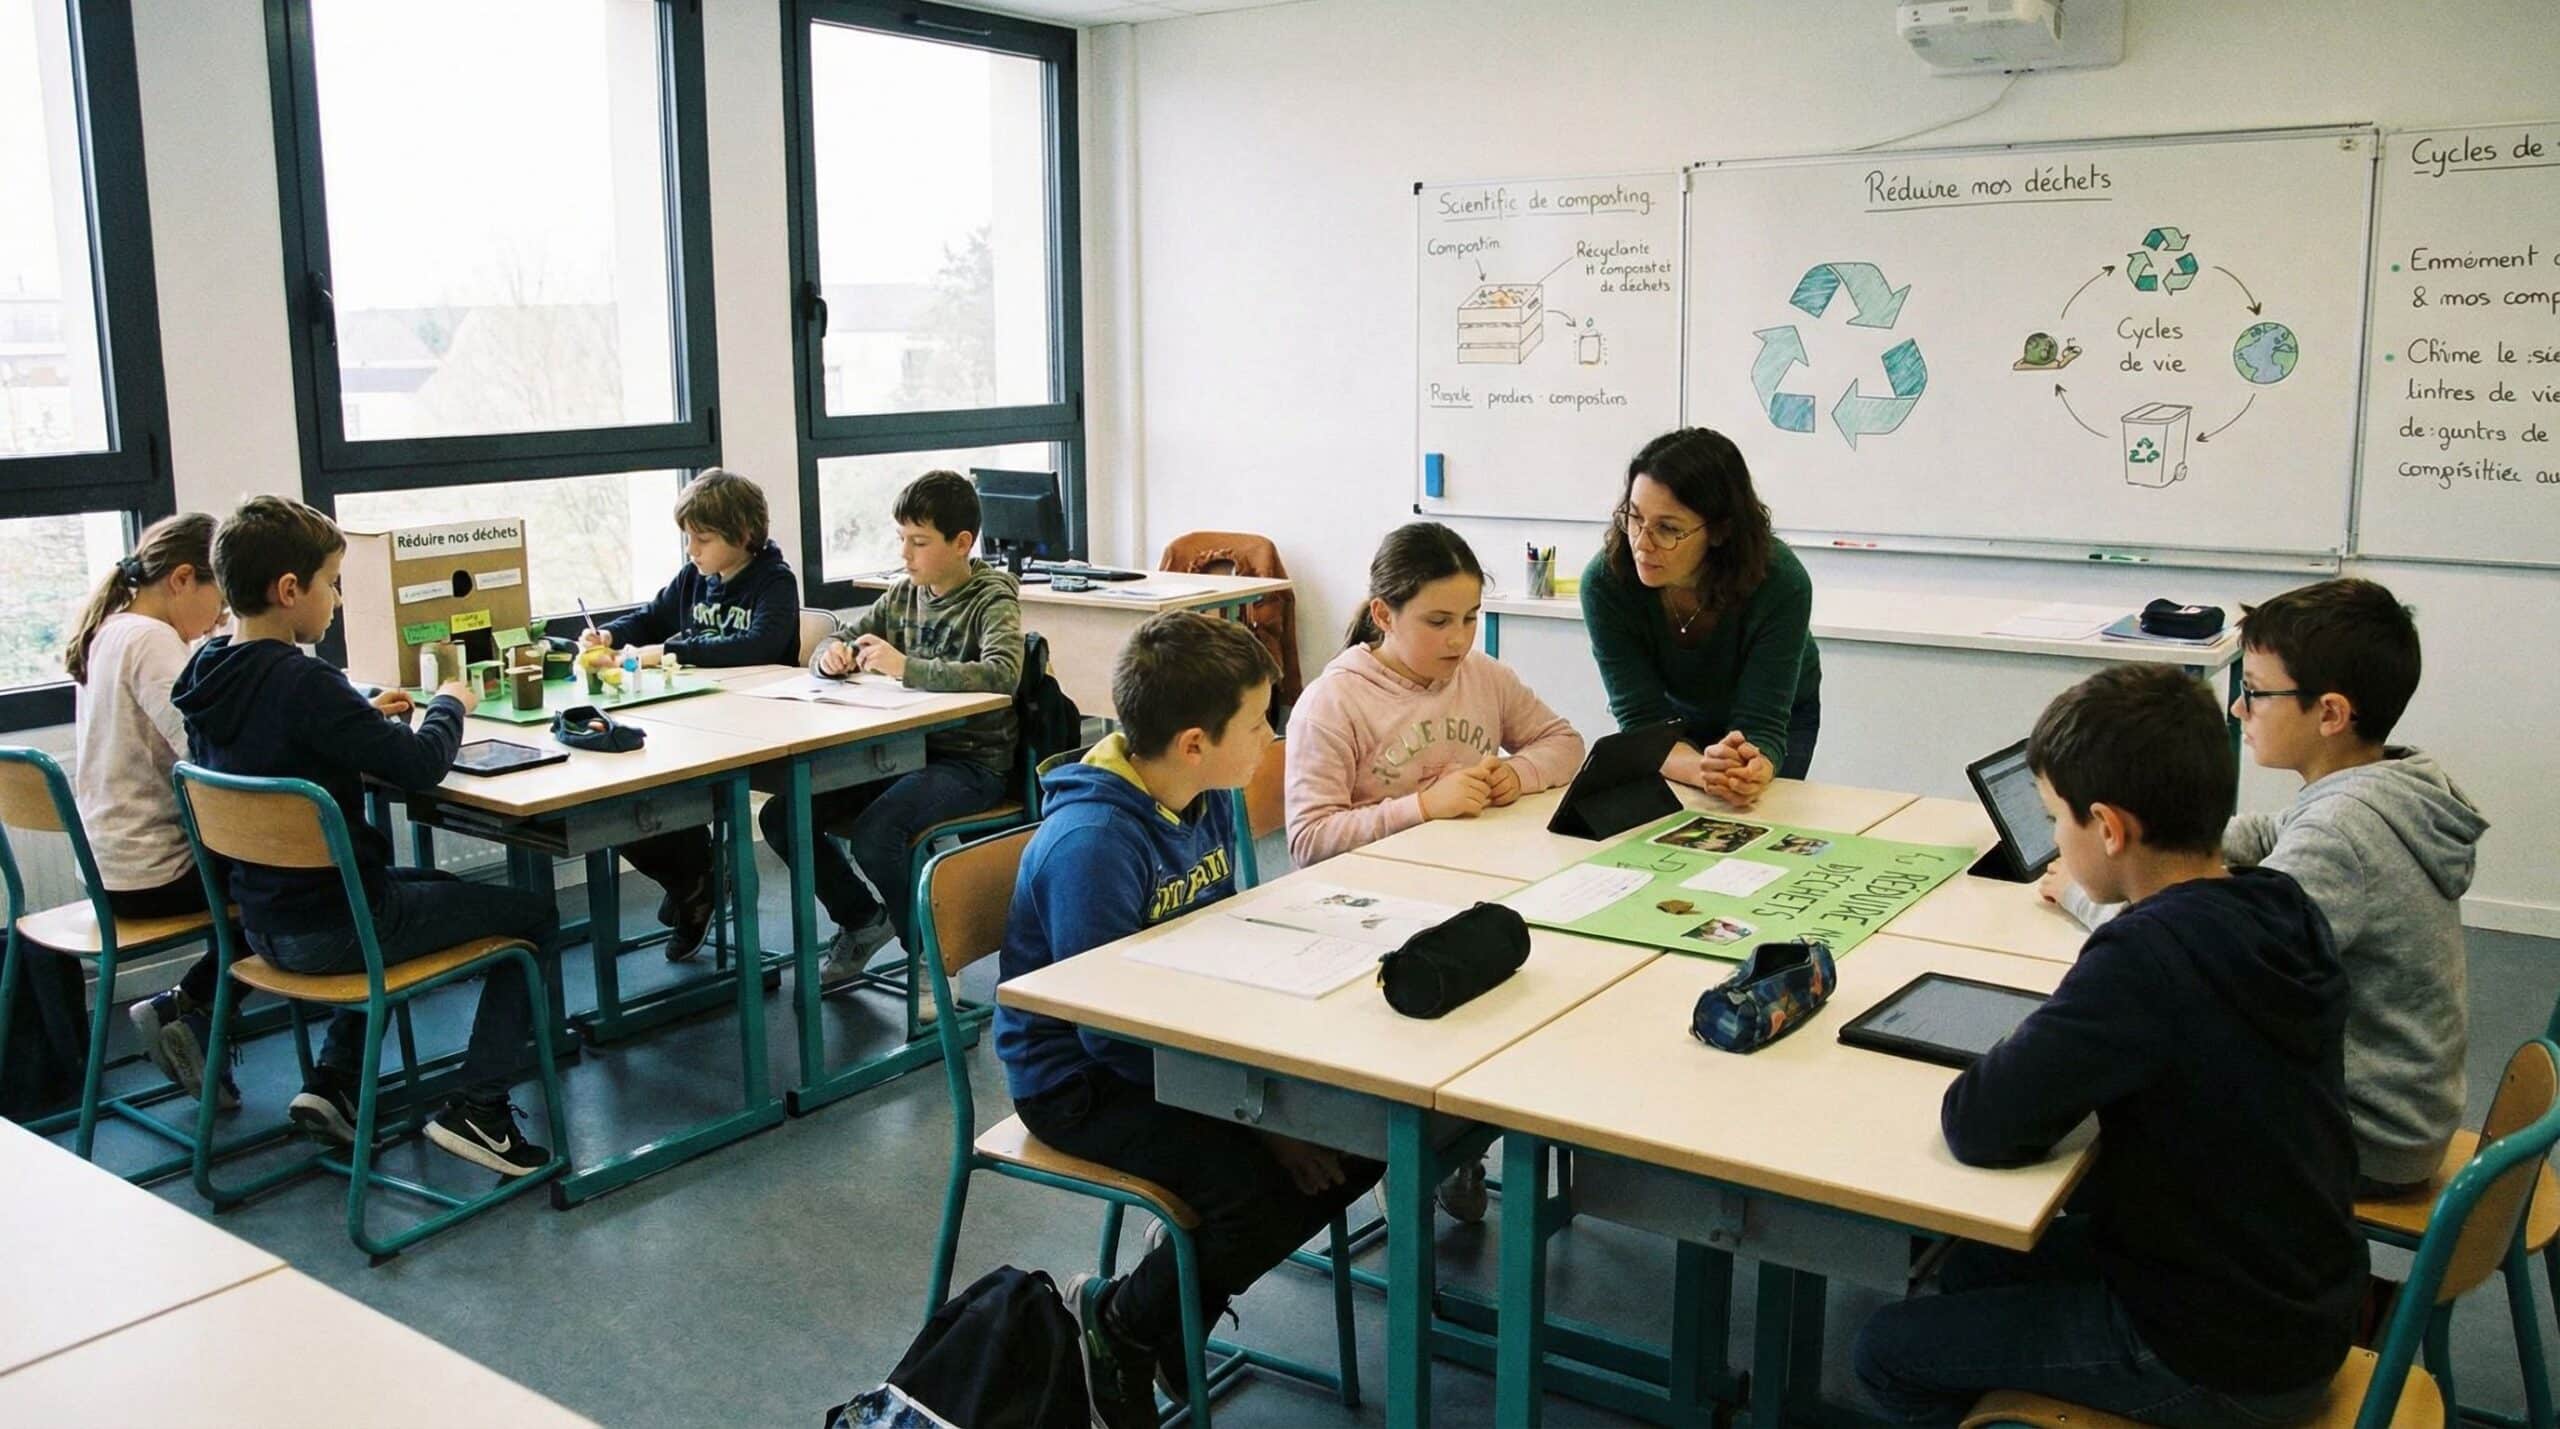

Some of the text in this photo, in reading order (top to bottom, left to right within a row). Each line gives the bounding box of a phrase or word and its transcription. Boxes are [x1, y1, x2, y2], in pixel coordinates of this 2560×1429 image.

[2411, 133, 2545, 178] Cycles de
[1864, 170, 1960, 204] Réduire
[2024, 163, 2112, 193] déchets
[1529, 190, 1548, 209] de
[1619, 278, 1670, 293] déchets
[2412, 285, 2429, 308] &
[2117, 316, 2183, 349] Cycles
[2119, 351, 2186, 373] de vie
[2498, 341, 2517, 363] le
[2488, 381, 2517, 402] de
[2521, 423, 2549, 442] de
[397, 526, 518, 548] Réduire nos déchets
